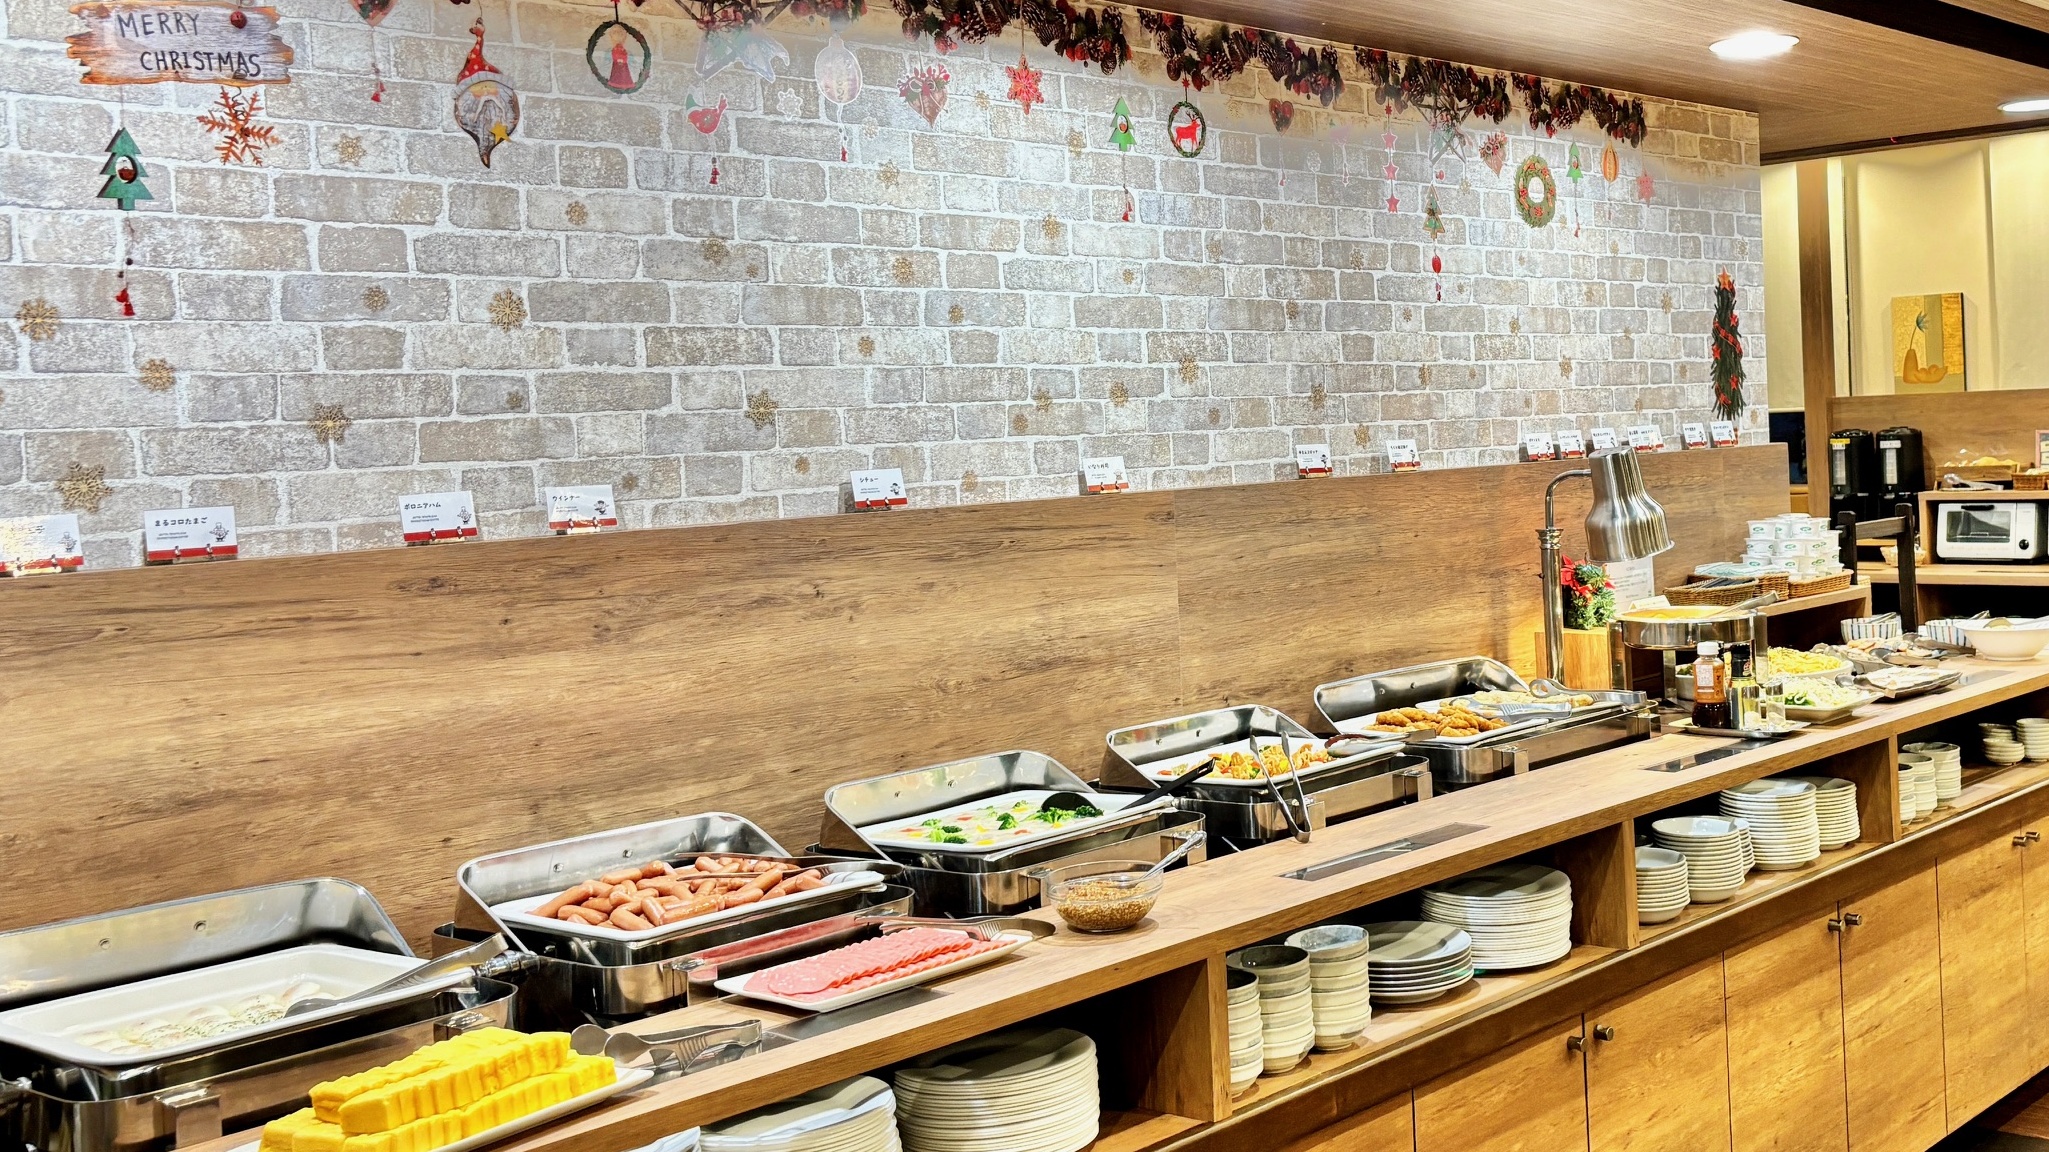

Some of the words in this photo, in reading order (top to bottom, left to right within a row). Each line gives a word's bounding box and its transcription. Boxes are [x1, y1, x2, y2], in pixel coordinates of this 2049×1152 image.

[116, 11, 200, 38] MERRY
[139, 50, 262, 78] CHRISTMAS
[154, 516, 209, 528] まるコロたまご
